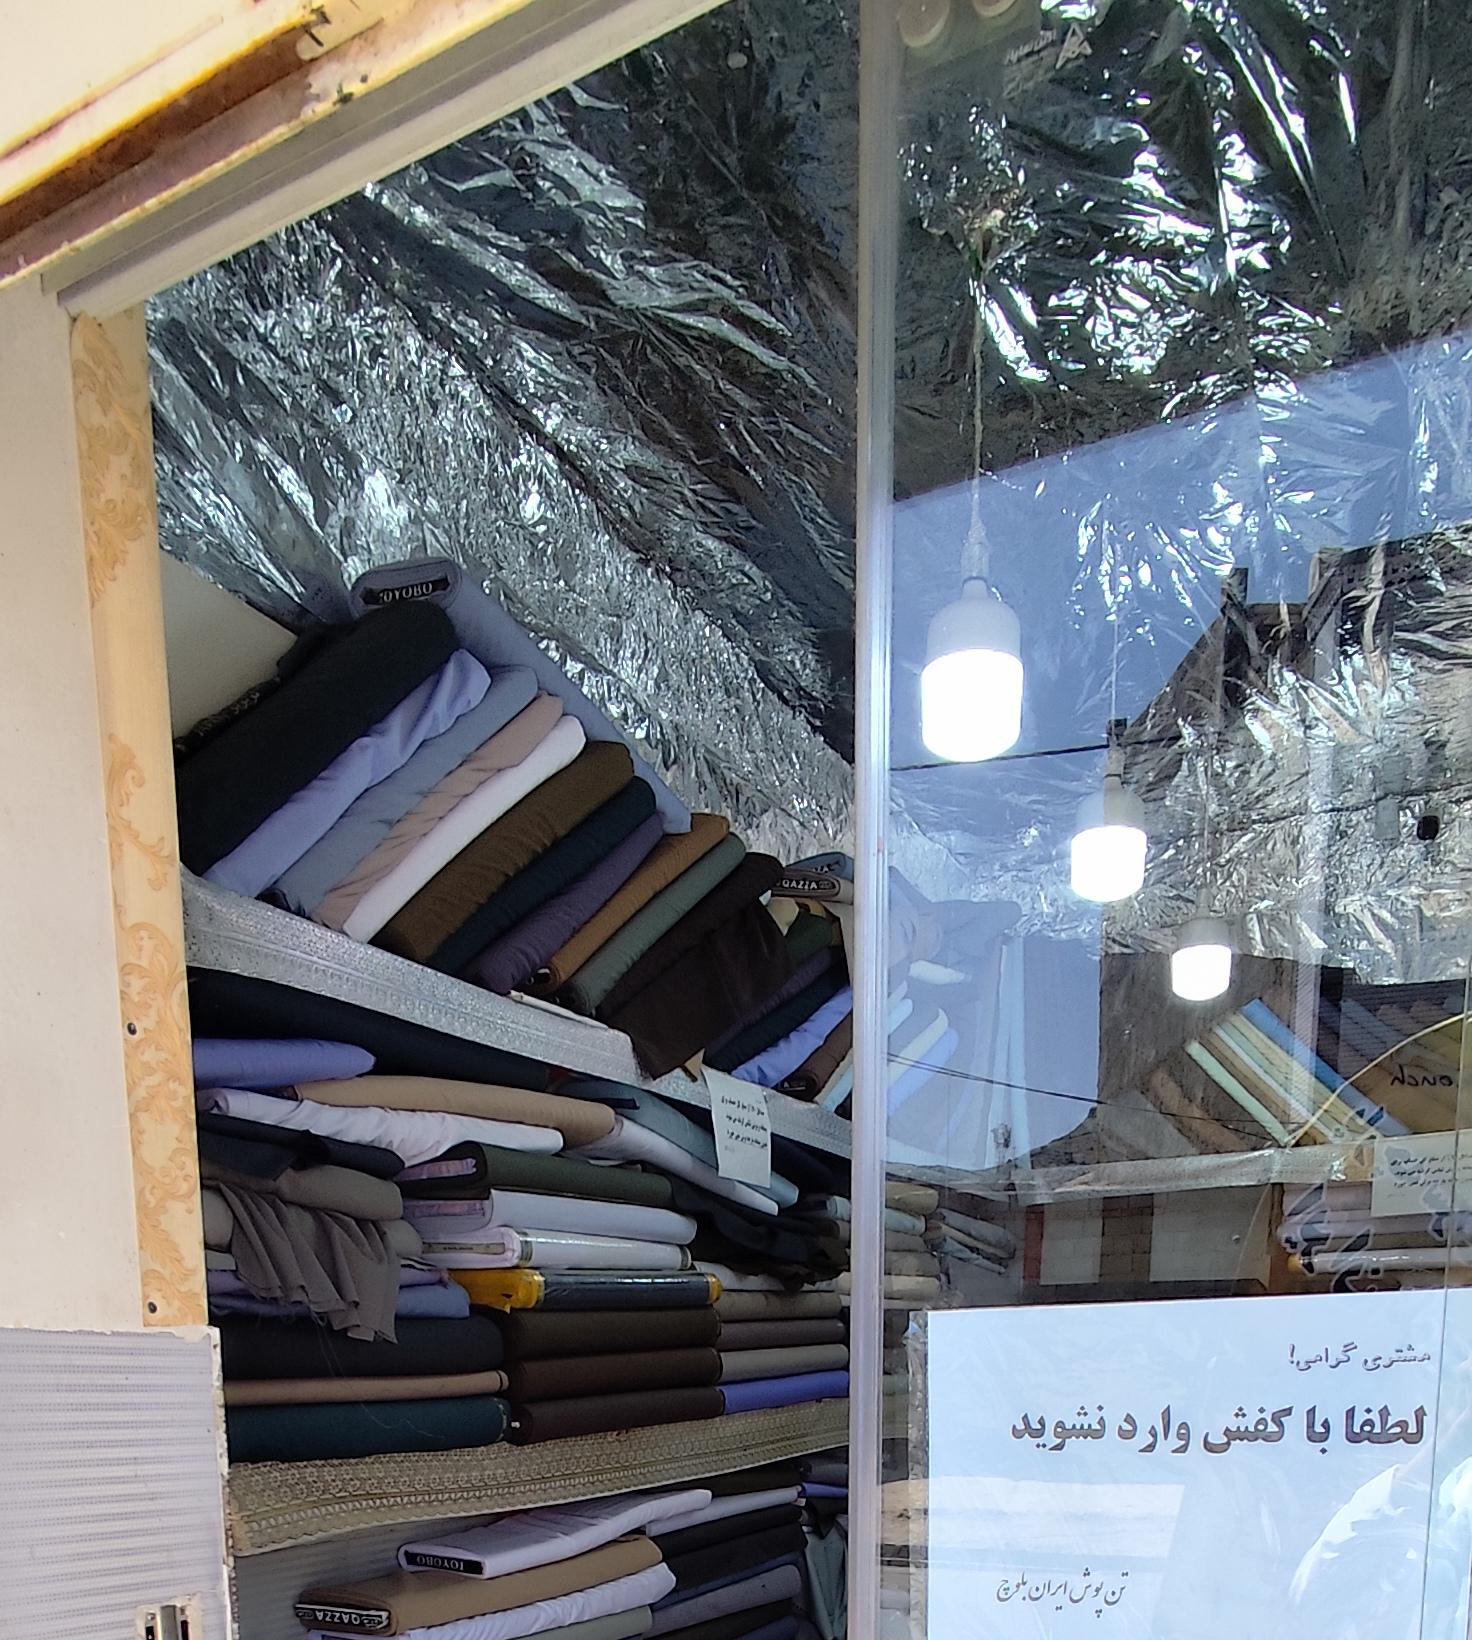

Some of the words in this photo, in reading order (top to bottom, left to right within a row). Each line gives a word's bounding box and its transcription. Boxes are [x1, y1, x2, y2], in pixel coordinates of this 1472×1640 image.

[379, 582, 433, 603] OYOBO
[782, 879, 818, 890] QAZZA
[1288, 1340, 1358, 1373] گرامی!
[1361, 1343, 1432, 1373] مشتری
[1011, 1404, 1107, 1453] نشوید
[1117, 1403, 1191, 1455] وارد
[1202, 1405, 1296, 1455] کفش
[1305, 1404, 1331, 1455] با
[1344, 1404, 1429, 1446] لطفا
[416, 1555, 464, 1571] TOYOBO
[996, 1571, 1028, 1603] بلوچ
[1028, 1579, 1068, 1612] ایران
[1069, 1566, 1104, 1619] پوش
[1103, 1571, 1129, 1607] تن
[315, 1610, 360, 1625] QAZZA
